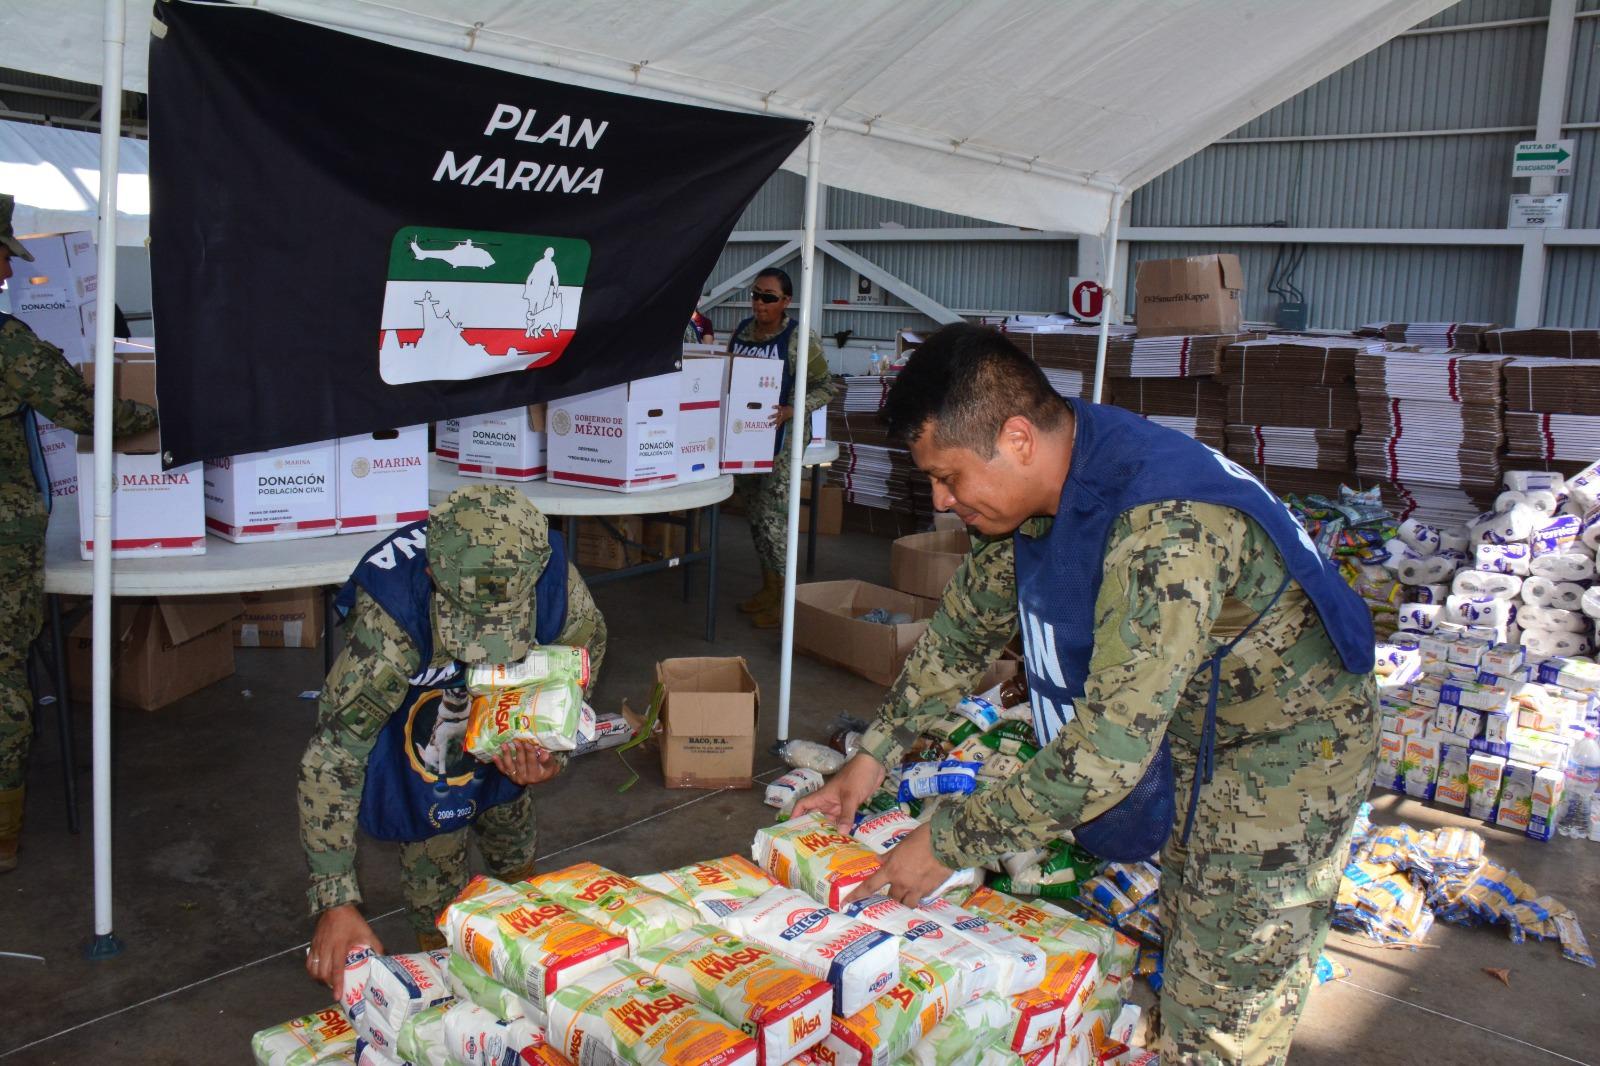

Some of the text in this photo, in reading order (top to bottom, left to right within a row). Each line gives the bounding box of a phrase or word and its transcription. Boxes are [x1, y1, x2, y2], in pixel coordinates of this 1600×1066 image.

[484, 103, 609, 150] PLAN
[432, 150, 604, 194] MARINA
[1185, 293, 1210, 302] Kappa
[21, 302, 66, 311] DONACIÓN
[574, 414, 623, 425] GOBIERNO DE
[472, 431, 517, 442] DONACIÓN
[574, 423, 623, 439] MÉXICO
[41, 442, 66, 453] ARINA
[472, 439, 502, 447] POBLACIÓN
[639, 440, 674, 451] DONACIÓN
[680, 443, 707, 454] MARINA
[284, 457, 311, 466] MARINA
[373, 456, 422, 469] MARINA
[122, 473, 190, 486] MARINA
[258, 473, 325, 487] DONACIÓN
[258, 486, 325, 495] POBLACIÓN CIVIL
[805, 834, 858, 852] MASA
[501, 904, 530, 924] hari
[511, 903, 571, 934] MASA
[784, 907, 834, 939] SELECTA
[691, 951, 722, 971] hari
[706, 946, 770, 981] MASA
[609, 994, 645, 1019] hari
[623, 993, 697, 1036] MASA
[793, 1016, 822, 1043] MASA
